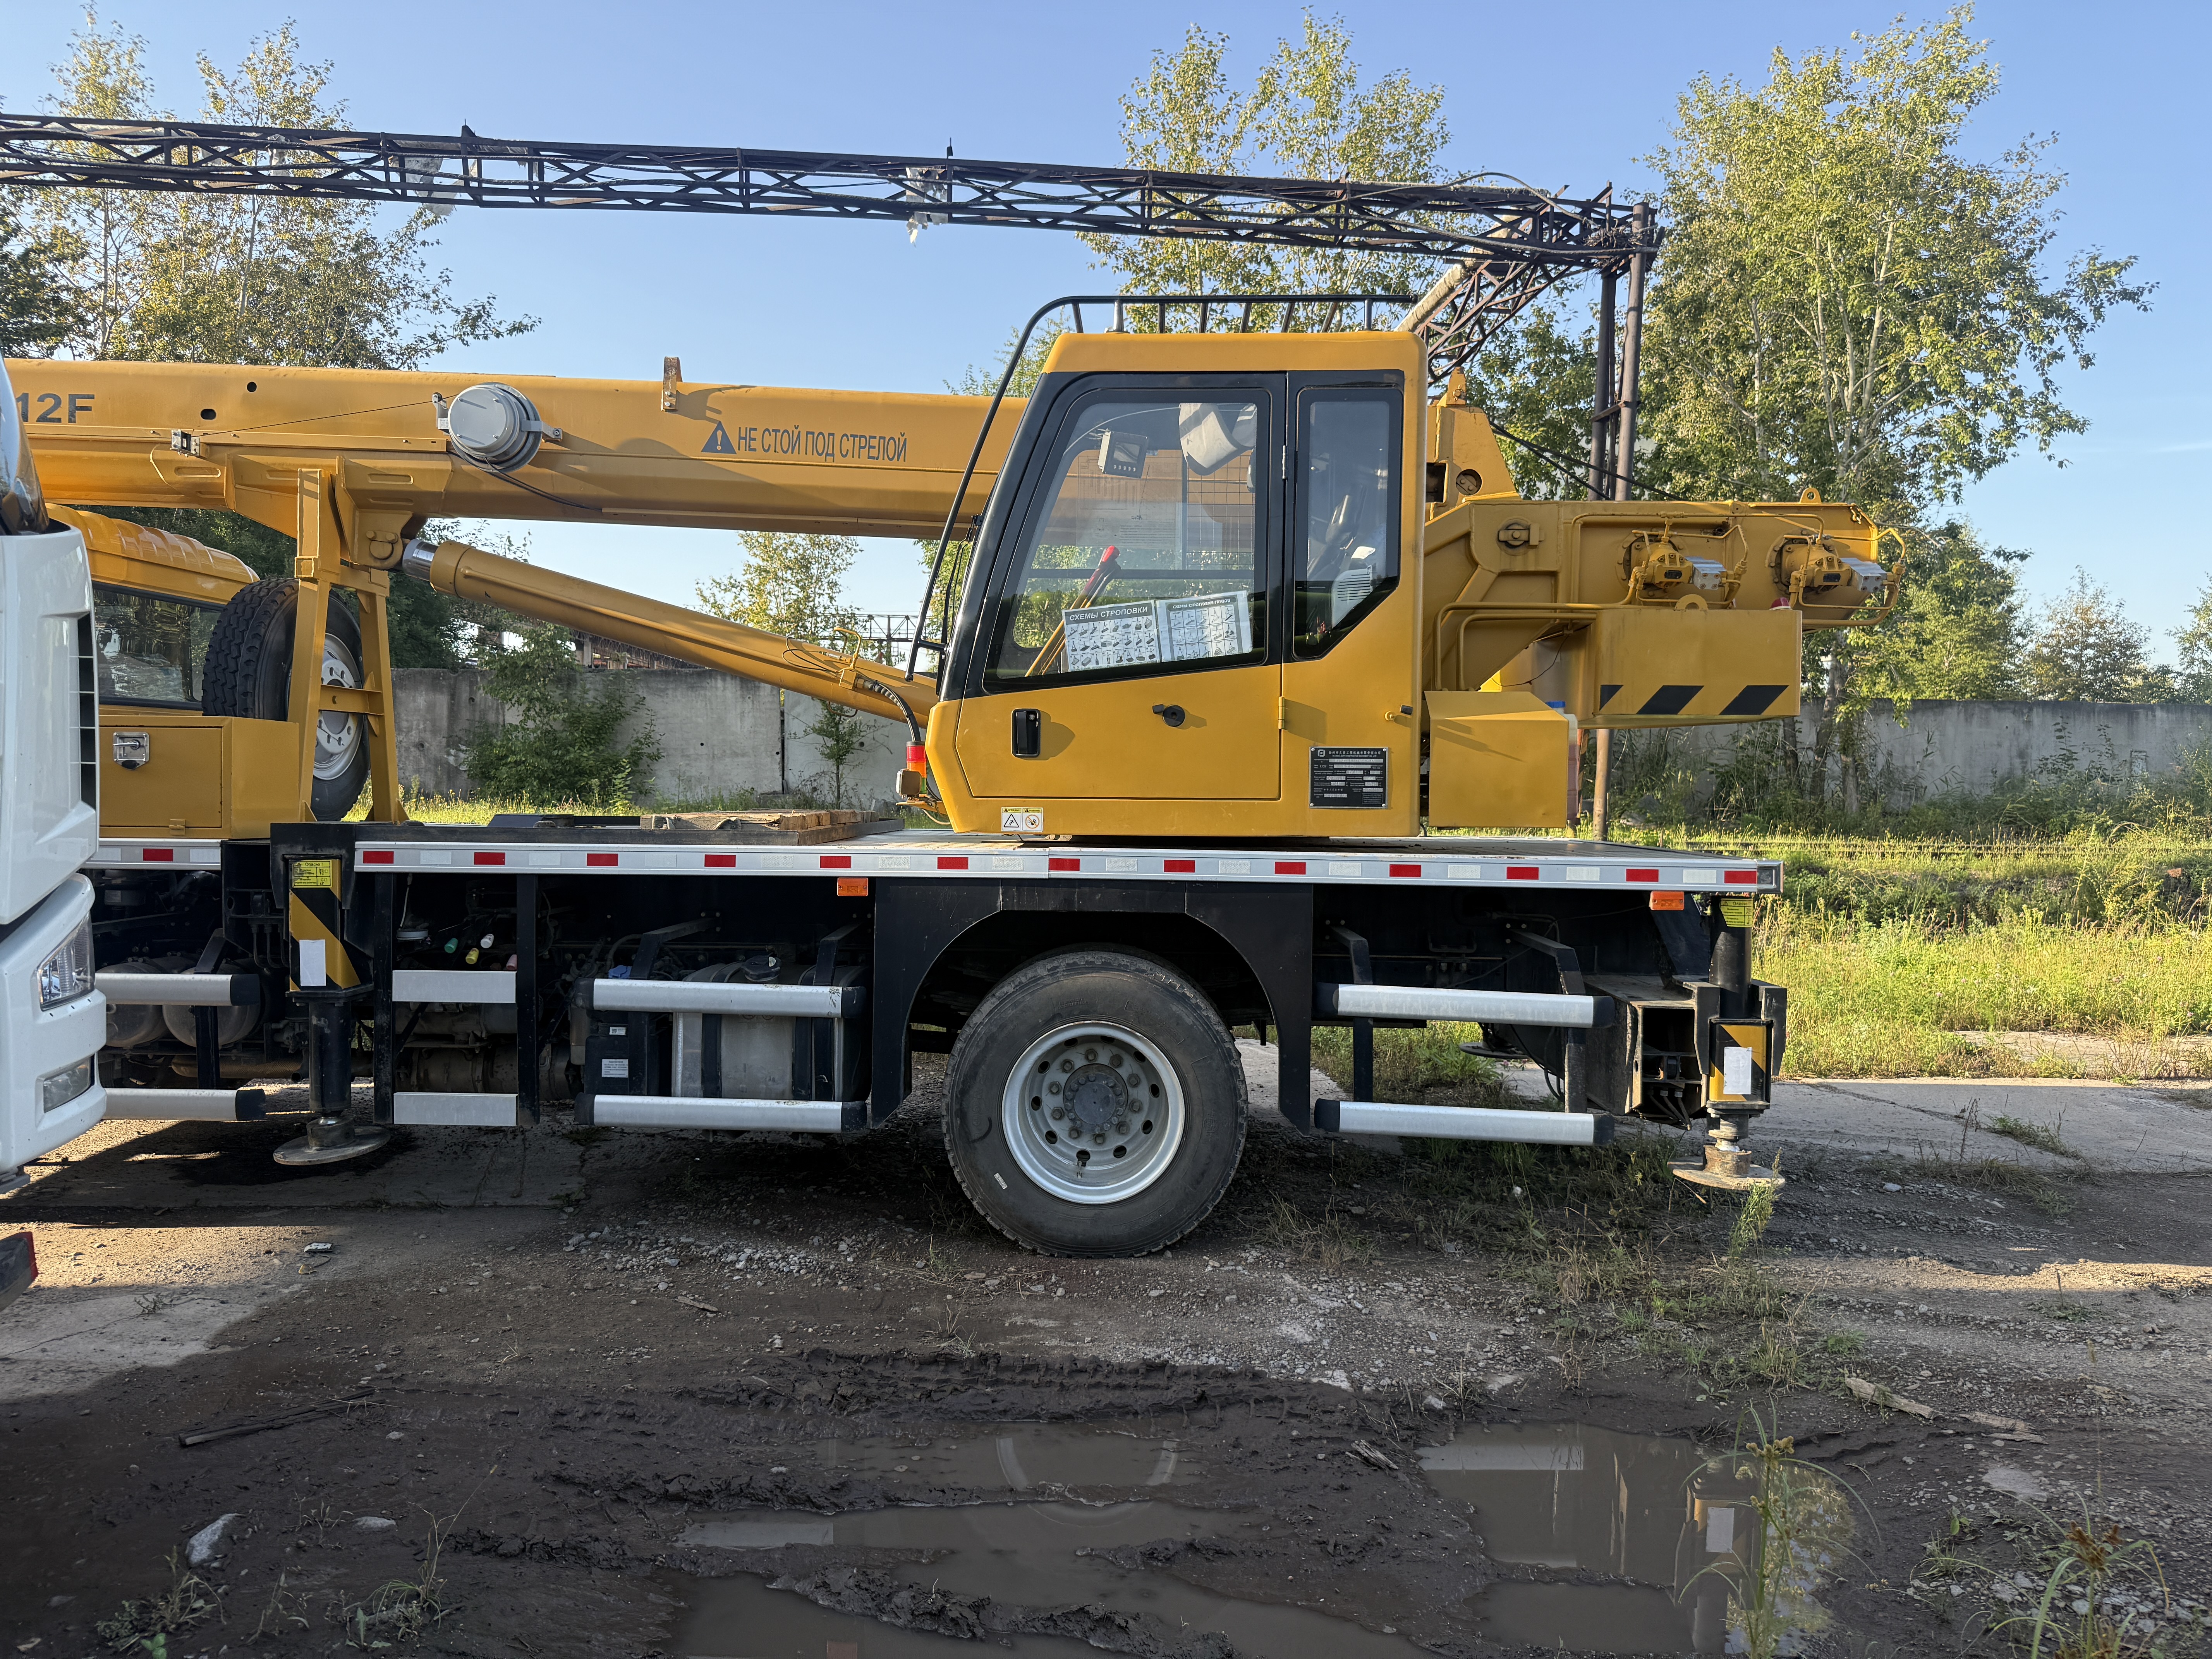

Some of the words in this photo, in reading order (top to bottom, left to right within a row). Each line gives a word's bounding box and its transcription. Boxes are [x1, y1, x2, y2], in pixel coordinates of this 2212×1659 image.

[738, 426, 757, 452] НЕ
[761, 424, 801, 455] СТОЙ
[805, 431, 835, 462] ПОД
[840, 432, 907, 462] СТРЕЛОЙ
[1070, 612, 1098, 621] СХЕМЫ
[1101, 606, 1148, 618] СТРОПОВКИ
